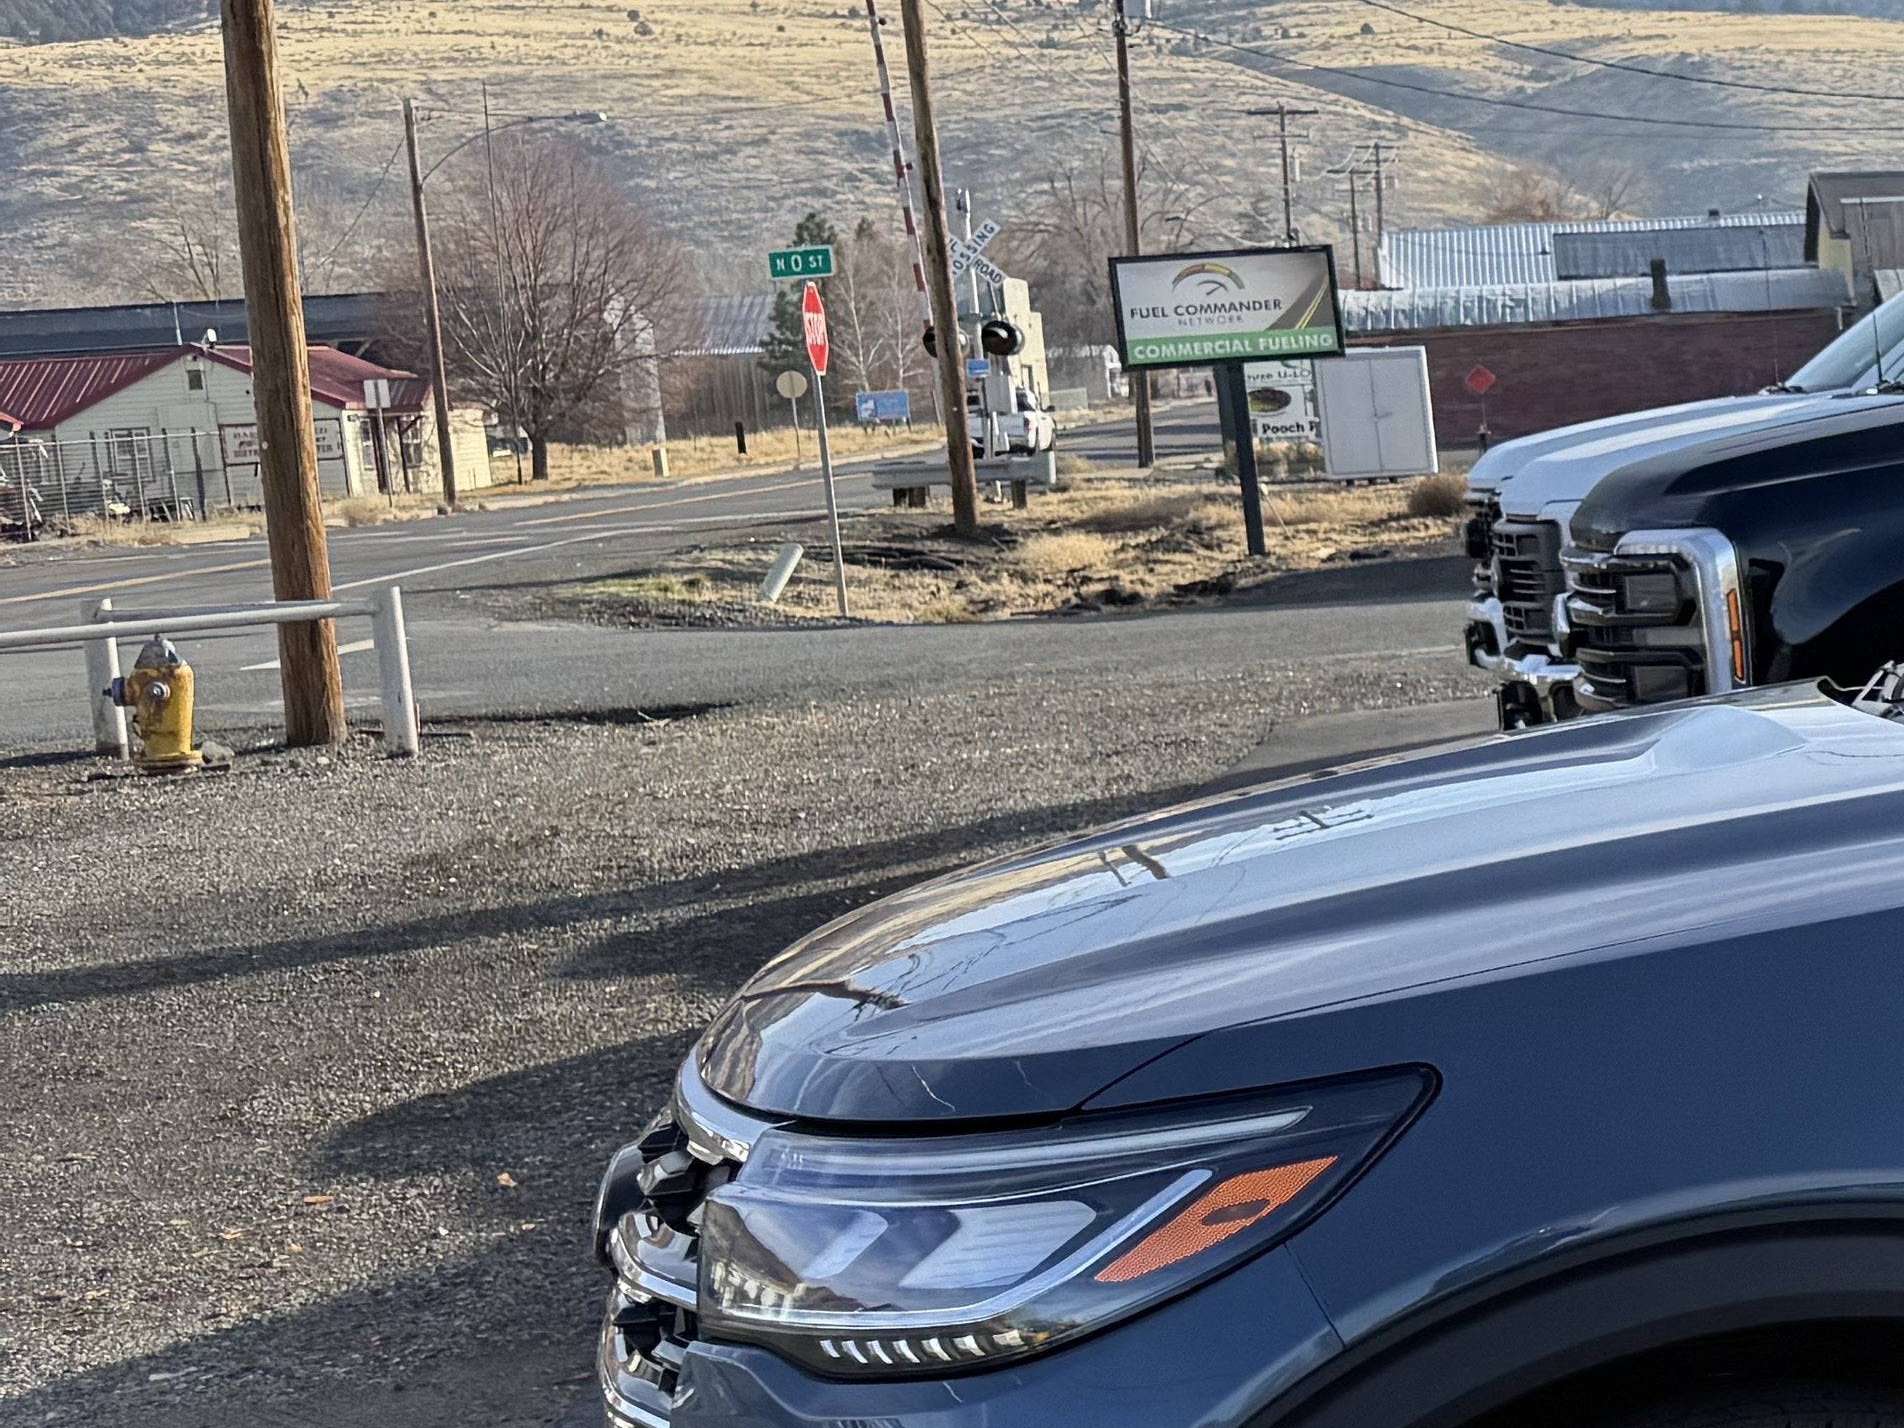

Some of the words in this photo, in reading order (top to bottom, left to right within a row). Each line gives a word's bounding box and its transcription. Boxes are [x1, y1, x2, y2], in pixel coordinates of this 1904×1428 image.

[952, 224, 995, 275] OSSING
[776, 258, 786, 270] N
[808, 255, 823, 270] ST
[974, 259, 1002, 283] ROAD
[1130, 306, 1169, 319] FUEL
[1174, 298, 1283, 316] COMMANDER
[805, 312, 827, 345] STOP
[1178, 315, 1244, 327] NETWORK
[1134, 339, 1254, 360] COMMERCIAL
[1258, 334, 1333, 351] FUELING
[1262, 422, 1305, 434] Pooch
